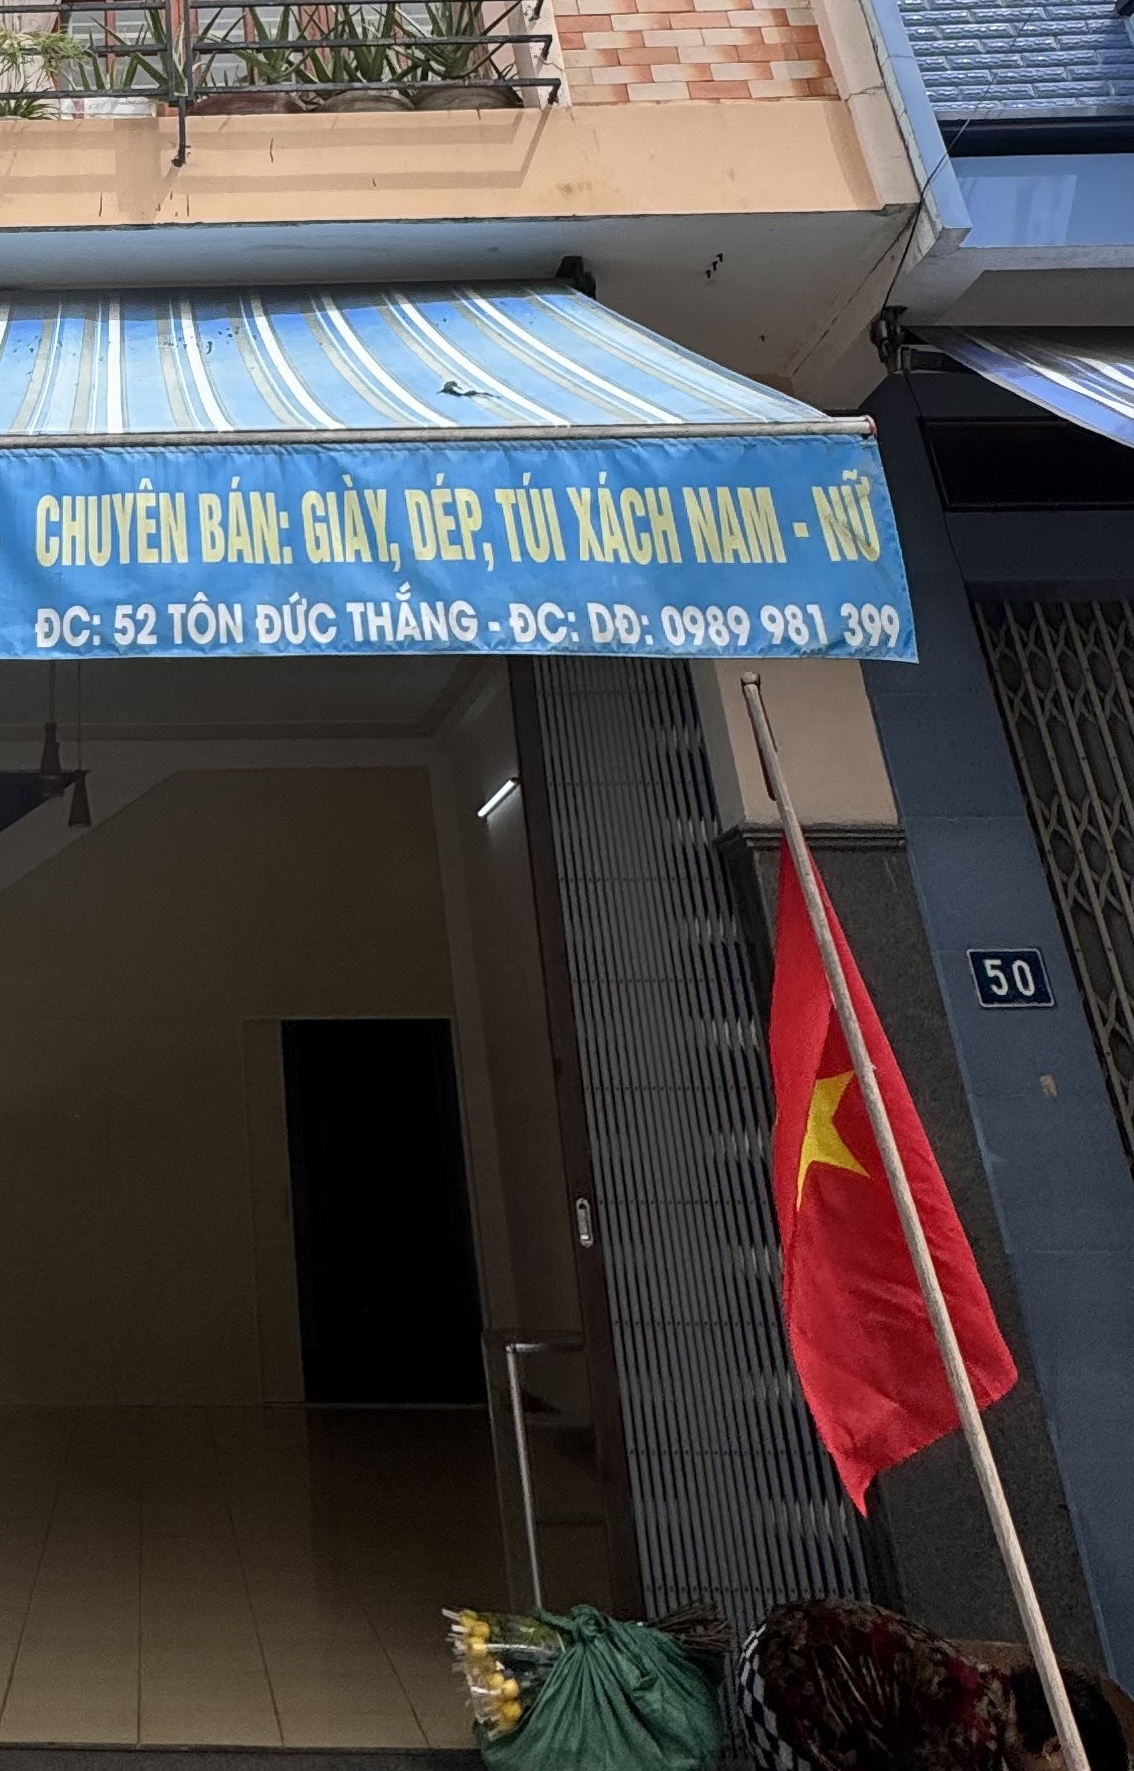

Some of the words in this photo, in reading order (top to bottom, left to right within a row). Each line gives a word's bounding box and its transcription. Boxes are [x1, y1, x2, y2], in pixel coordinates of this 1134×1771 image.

[35, 477, 189, 567] CHUYÊN
[198, 476, 293, 565] BÁN:
[301, 473, 401, 572] GIÀY,
[405, 473, 494, 572] DÉP,
[495, 472, 566, 563] TÚI
[567, 471, 683, 565] XÁCH
[683, 486, 787, 564] NAM
[812, 469, 880, 562] NỮ
[34, 605, 101, 648] ĐC:
[113, 604, 158, 645] 52
[168, 591, 244, 645] TÔN
[256, 591, 337, 645] ĐỨC
[346, 581, 478, 642] THẮNG
[508, 602, 580, 643] ĐC:
[587, 602, 654, 645] DĐ:
[660, 604, 750, 647] 0989
[760, 604, 829, 645] 981
[840, 602, 900, 648] 399
[983, 959, 1036, 997] 50
